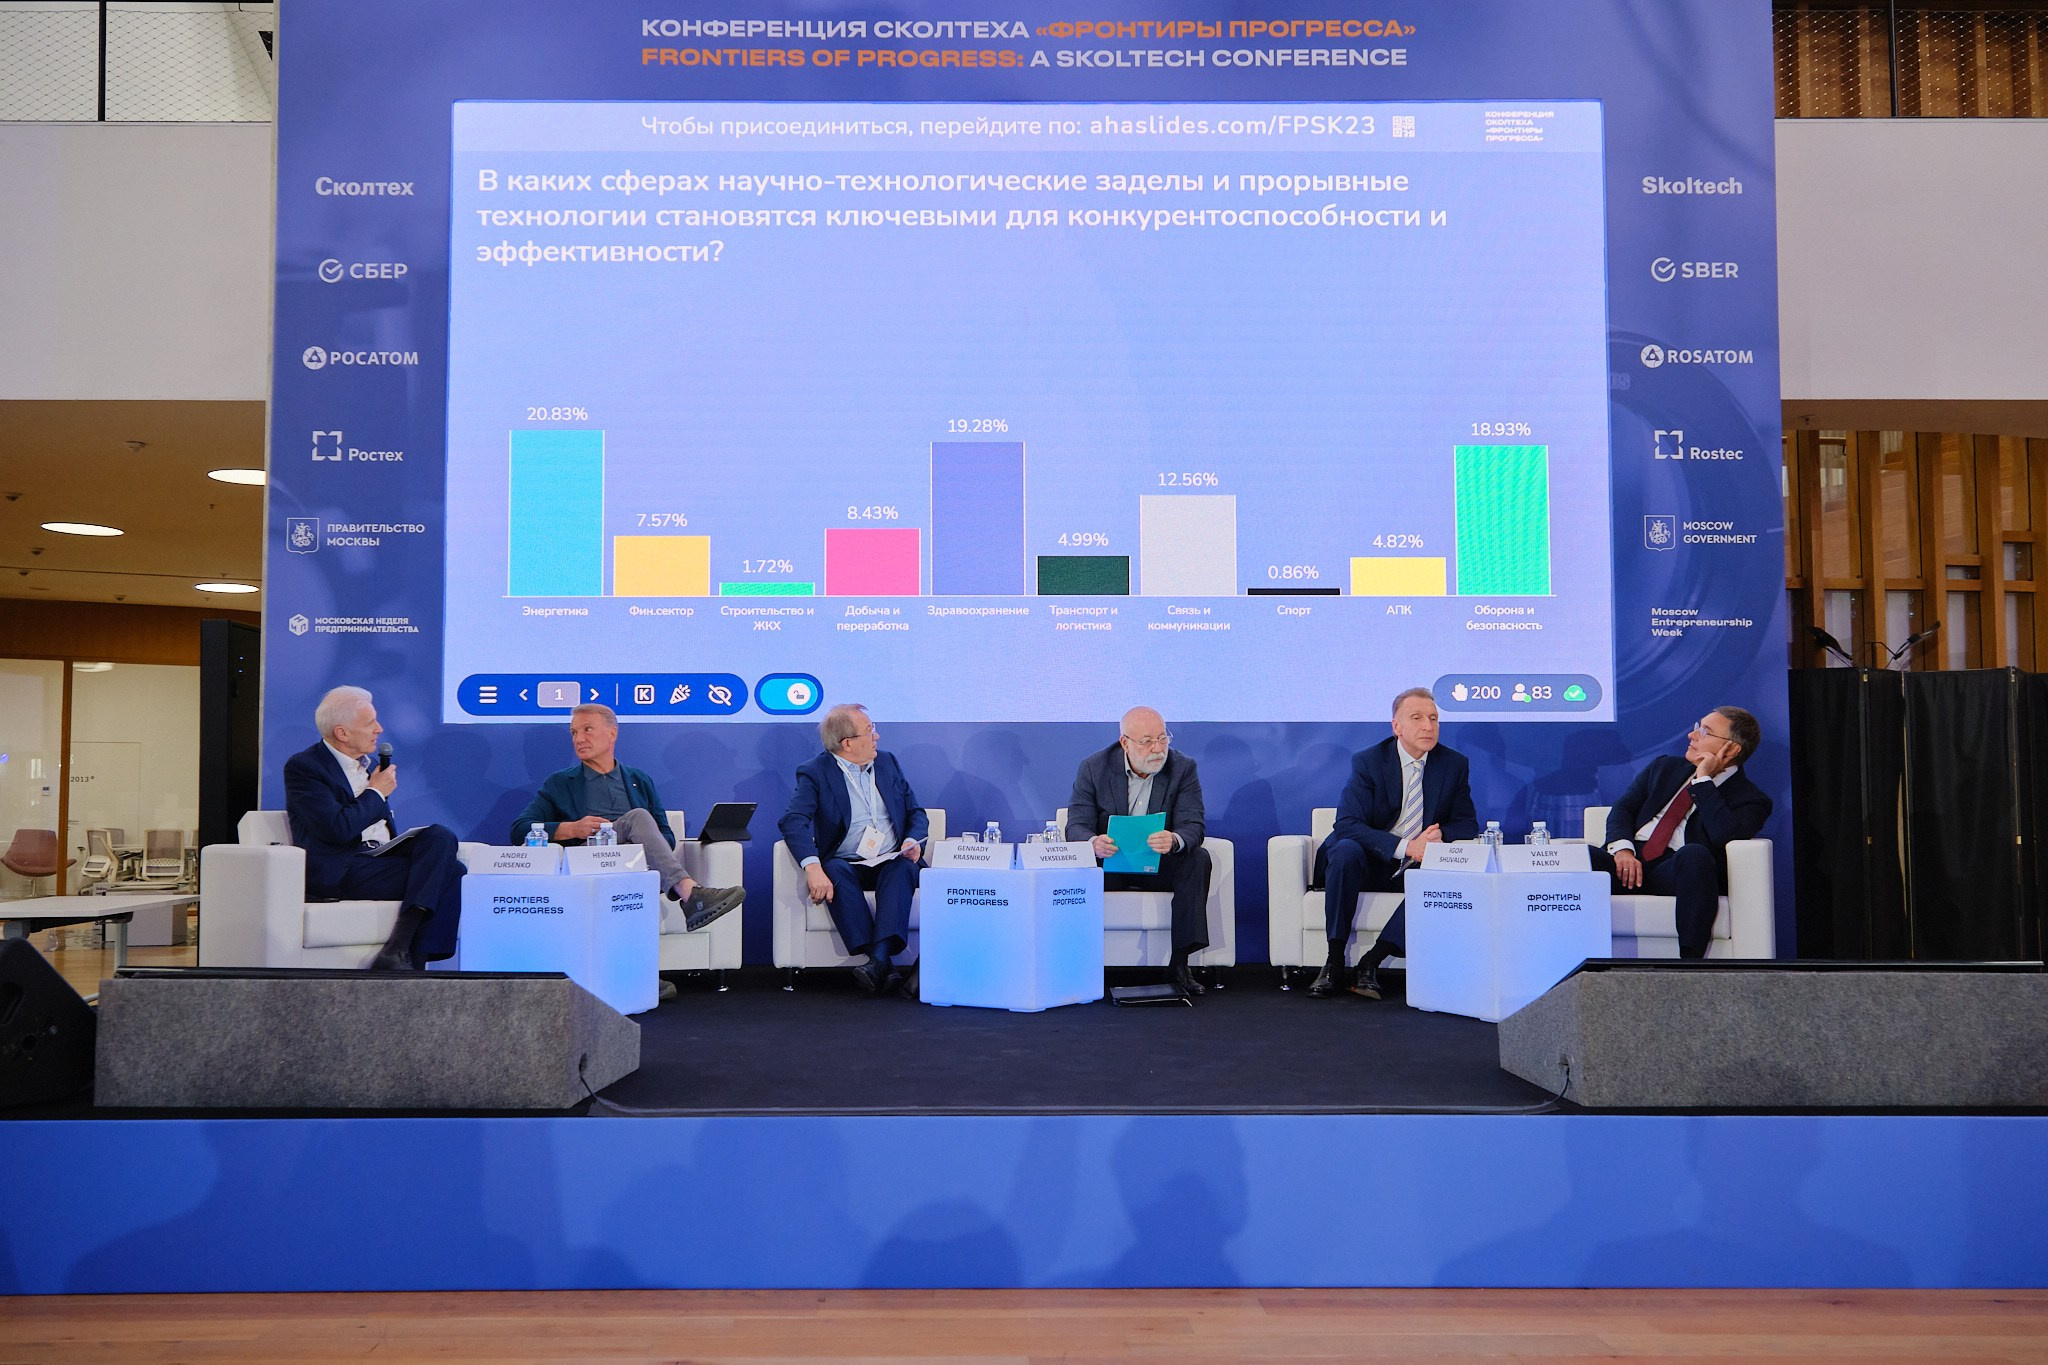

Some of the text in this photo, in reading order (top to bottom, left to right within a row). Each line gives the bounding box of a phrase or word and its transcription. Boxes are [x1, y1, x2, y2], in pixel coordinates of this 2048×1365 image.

[642, 19, 1416, 40] КОНФЕРЕНЦИЯ СКОЛТЕХА «ФРОНТИРЫ ПРОГРЕССА»
[642, 49, 1407, 67] FRONTIERS OF PROGRESS: A SKOLTECH CONFERENCE
[642, 115, 1376, 139] Чтобы присоединиться, перейдите по: ahaslides.com/FPSK23
[315, 176, 415, 196] Сколтех
[478, 169, 1409, 198] В каких сферах научно-технологические заделы и прорывные
[1642, 176, 1743, 195] Skoltech
[477, 205, 1447, 232] технологии становятся ключевыми для конкурентоспособности и
[477, 241, 724, 267] эффективности?
[350, 263, 408, 279] СБЕР
[1681, 262, 1739, 279] SBER
[330, 351, 419, 365] РОСАТОМ
[1668, 350, 1754, 364] ROSATOM
[527, 407, 588, 421] 20.83%
[948, 419, 1009, 433] 19.28%
[1471, 422, 1531, 437] 18.93%
[348, 448, 404, 462] Ростех
[1690, 447, 1744, 460] Rostec
[1158, 472, 1219, 487] 12.56%
[847, 506, 899, 520] 8.43%
[636, 513, 688, 527] 7.57%
[327, 524, 426, 534] ПРАВИТЕЛЬСТВО
[1683, 522, 1734, 531] MOSCOW
[327, 537, 380, 547] МОСКВЫ
[1058, 533, 1109, 547] 4.99%
[1373, 534, 1424, 549] 4.82%
[1683, 534, 1757, 544] GOVERNMENT
[742, 559, 794, 573] 1.72%
[1268, 565, 1319, 580] 0.86%
[522, 605, 589, 617] Энергетика
[629, 605, 694, 618] Фин.сектор
[720, 605, 814, 617] Строительство и
[845, 605, 900, 617] Добыча и
[927, 605, 1030, 617] Здравоохранение
[1049, 605, 1118, 617] Транспорт и
[1167, 605, 1211, 616] Связь и
[1277, 605, 1312, 617] Спорт
[1386, 605, 1412, 616] АПК
[1474, 605, 1535, 616] Оборона и
[1651, 608, 1699, 616] Moscow
[315, 617, 409, 625] МОСКОВСКАЯ НЕДЕЛЯ
[753, 620, 781, 631] ЖКХ
[836, 620, 909, 633] переработка
[1055, 622, 1112, 631] логистика
[1147, 621, 1231, 632] коммуникации
[1466, 620, 1543, 631] безопасность
[1651, 618, 1753, 627] Entrepreneurship
[1651, 629, 1683, 637] Week
[554, 689, 564, 700] 1
[1471, 686, 1501, 700] 200
[1531, 686, 1552, 700] 83
[957, 845, 989, 853] GENNADY
[953, 854, 991, 862] KRASNIKOV
[1040, 854, 1077, 862] VEKSELBERG
[1439, 856, 1469, 864] SHUVALOV
[1532, 859, 1560, 867] FALKOV
[611, 892, 644, 902] ФРОНТИРЫ
[947, 888, 996, 896] FRONTIERS
[1052, 888, 1086, 896] ФРОНТИРЫ
[1423, 891, 1462, 899] FRONTIERS
[1527, 894, 1581, 902] ФРОНТИРЫ
[493, 896, 550, 904] FRONTIERS
[960, 898, 1009, 906] PROGRESS
[1052, 898, 1086, 906] ПРОГРЕССА
[1433, 901, 1473, 910] PROGRESS
[611, 902, 644, 913] ПРОГРЕССА
[1527, 904, 1582, 912] ПРОГРЕССА
